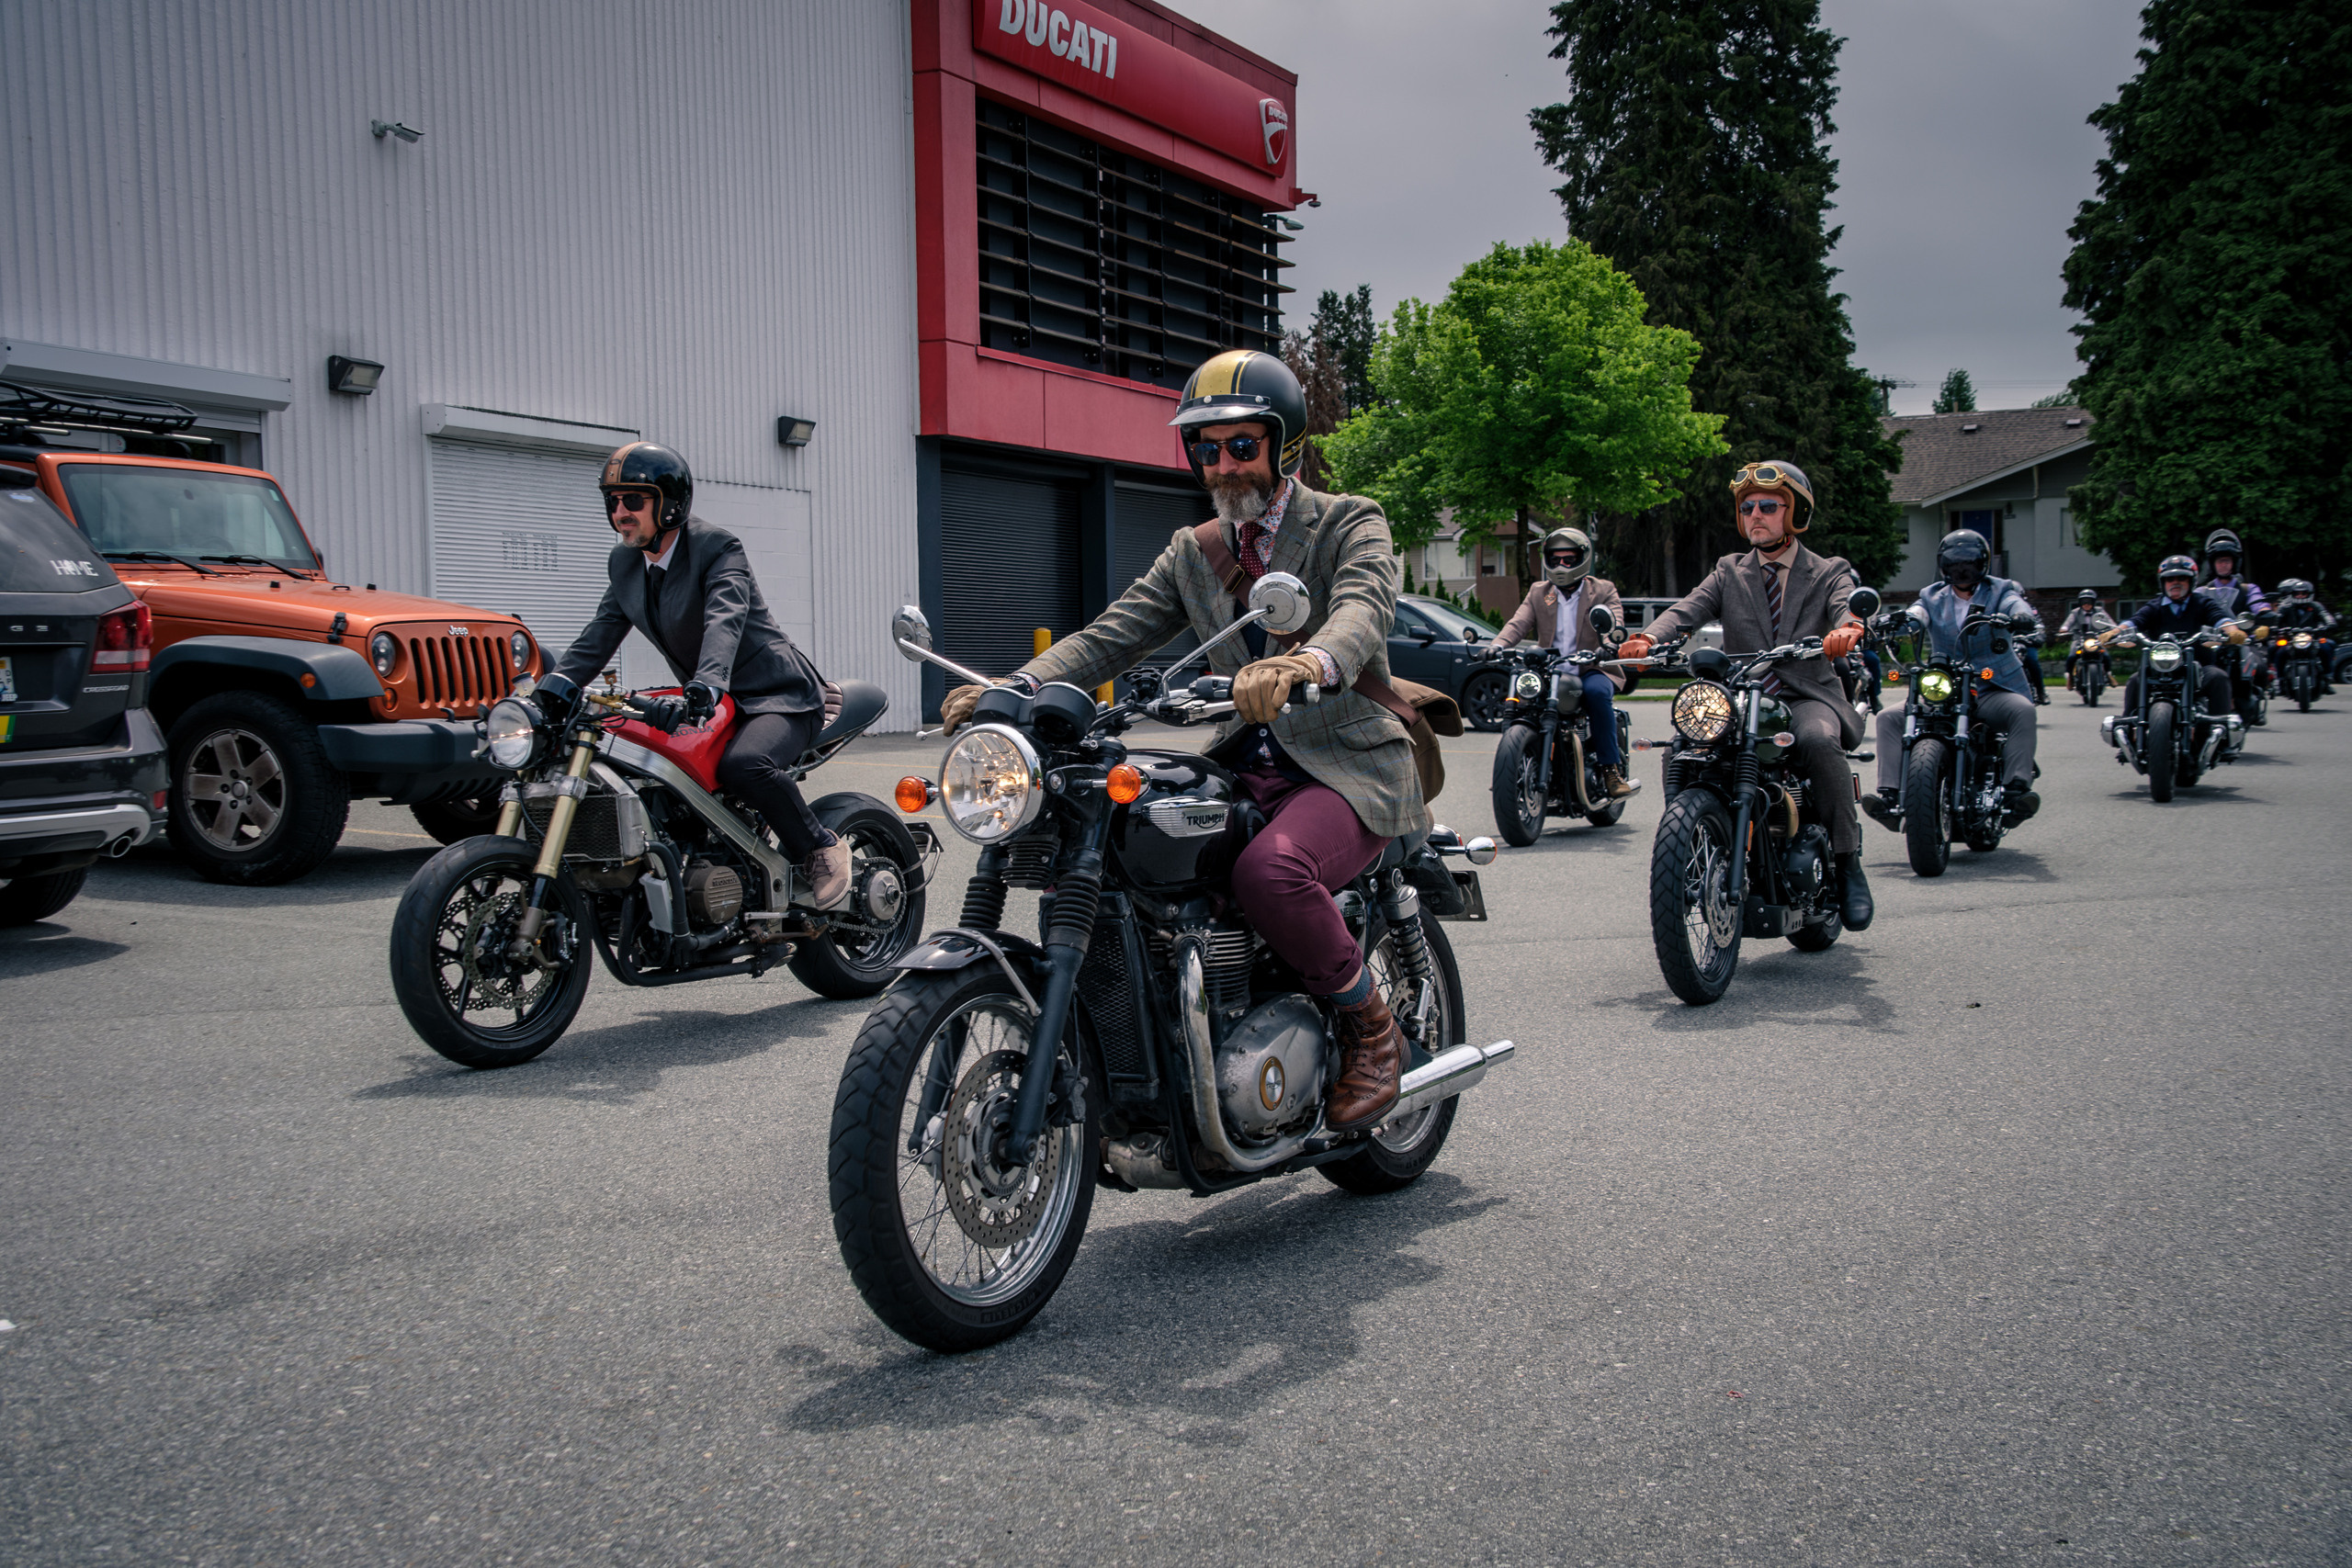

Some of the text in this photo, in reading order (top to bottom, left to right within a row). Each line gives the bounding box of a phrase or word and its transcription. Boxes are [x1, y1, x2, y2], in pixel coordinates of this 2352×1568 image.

[999, 0, 1117, 79] DUCATI
[448, 625, 469, 637] Jeep
[670, 726, 715, 739] HONDA
[1186, 813, 1225, 829] TRIUMPH
